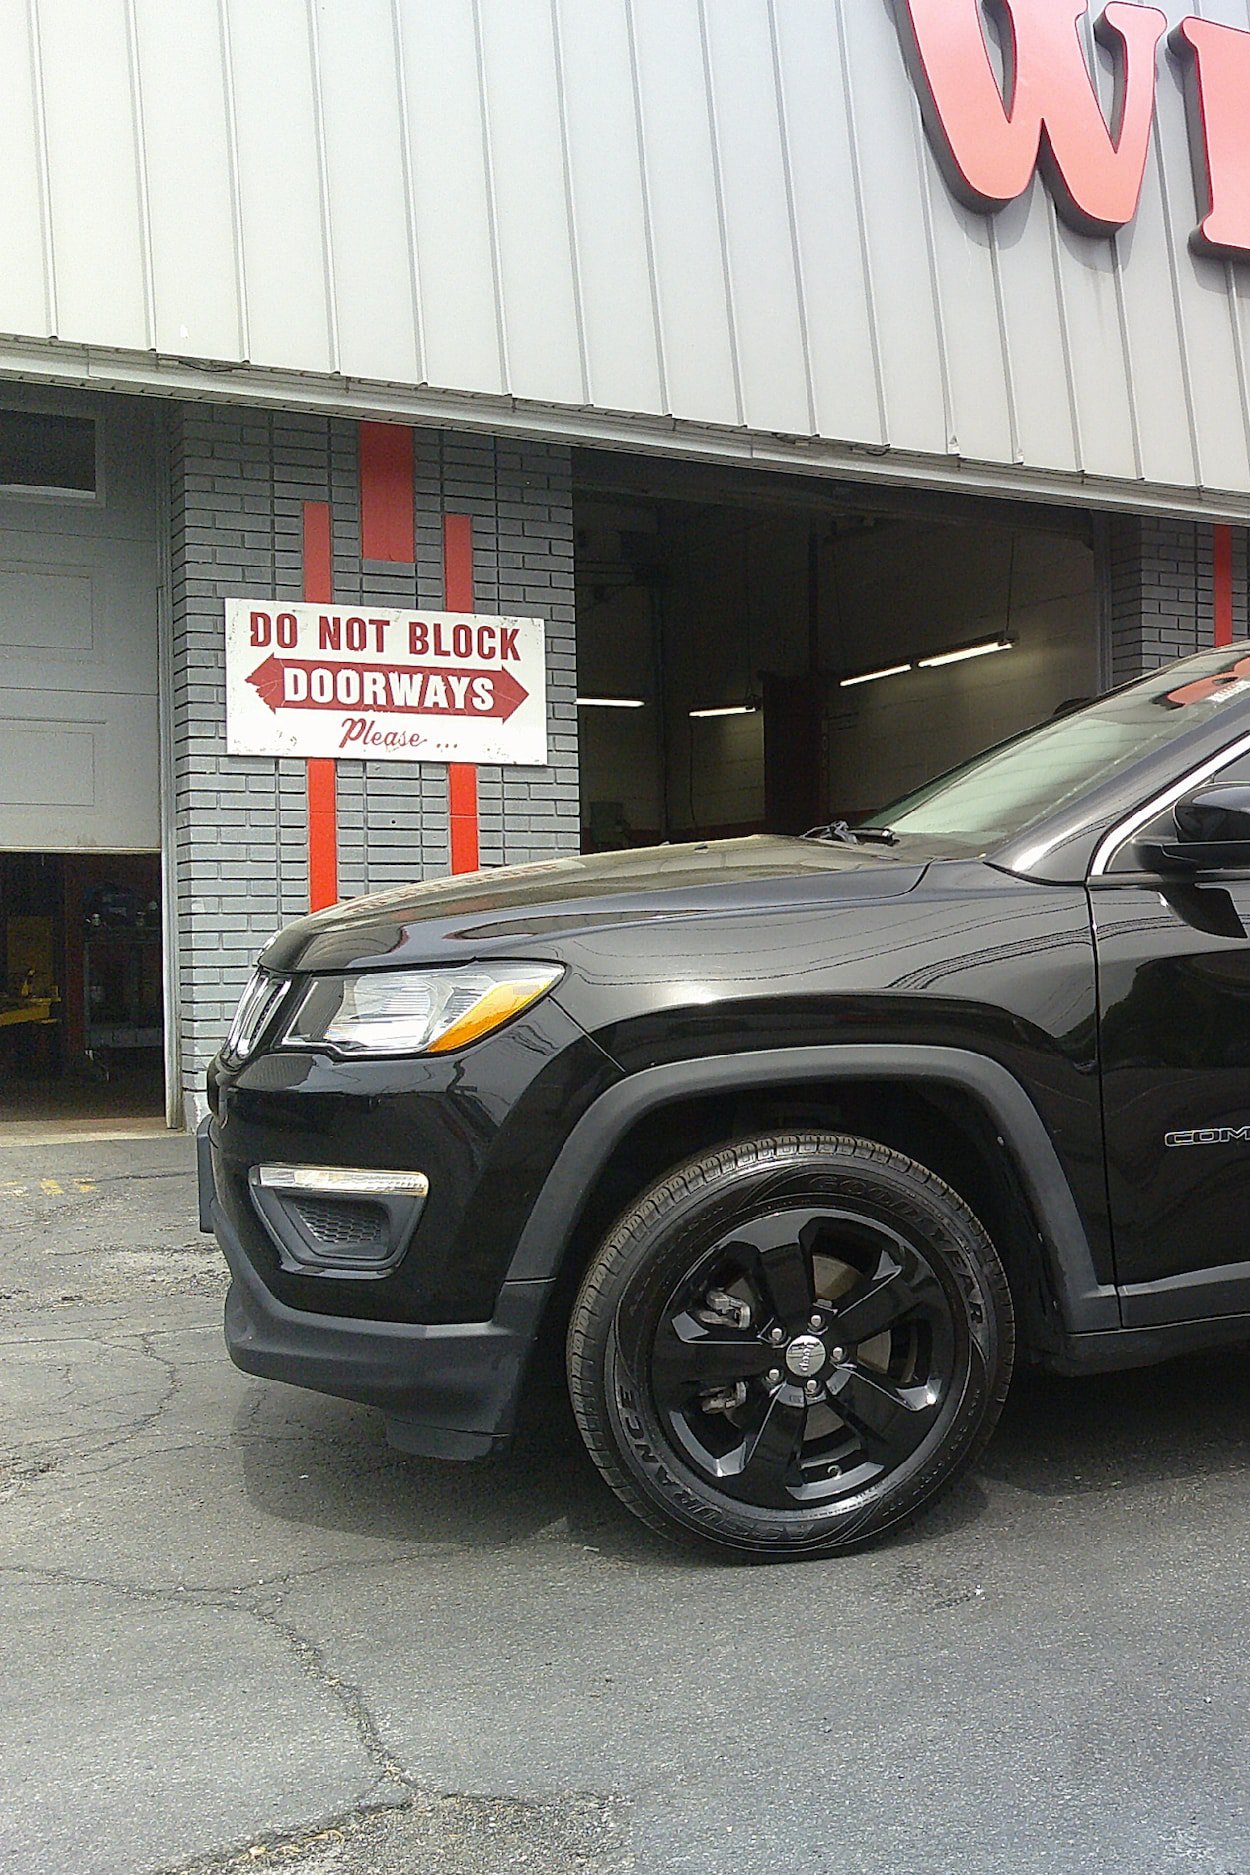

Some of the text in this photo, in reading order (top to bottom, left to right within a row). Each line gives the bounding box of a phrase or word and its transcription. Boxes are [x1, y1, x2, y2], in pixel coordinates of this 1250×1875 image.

[250, 612, 521, 661] DO NOT BLOCK
[283, 667, 495, 711] DOORWAYS
[339, 718, 428, 749] Please
